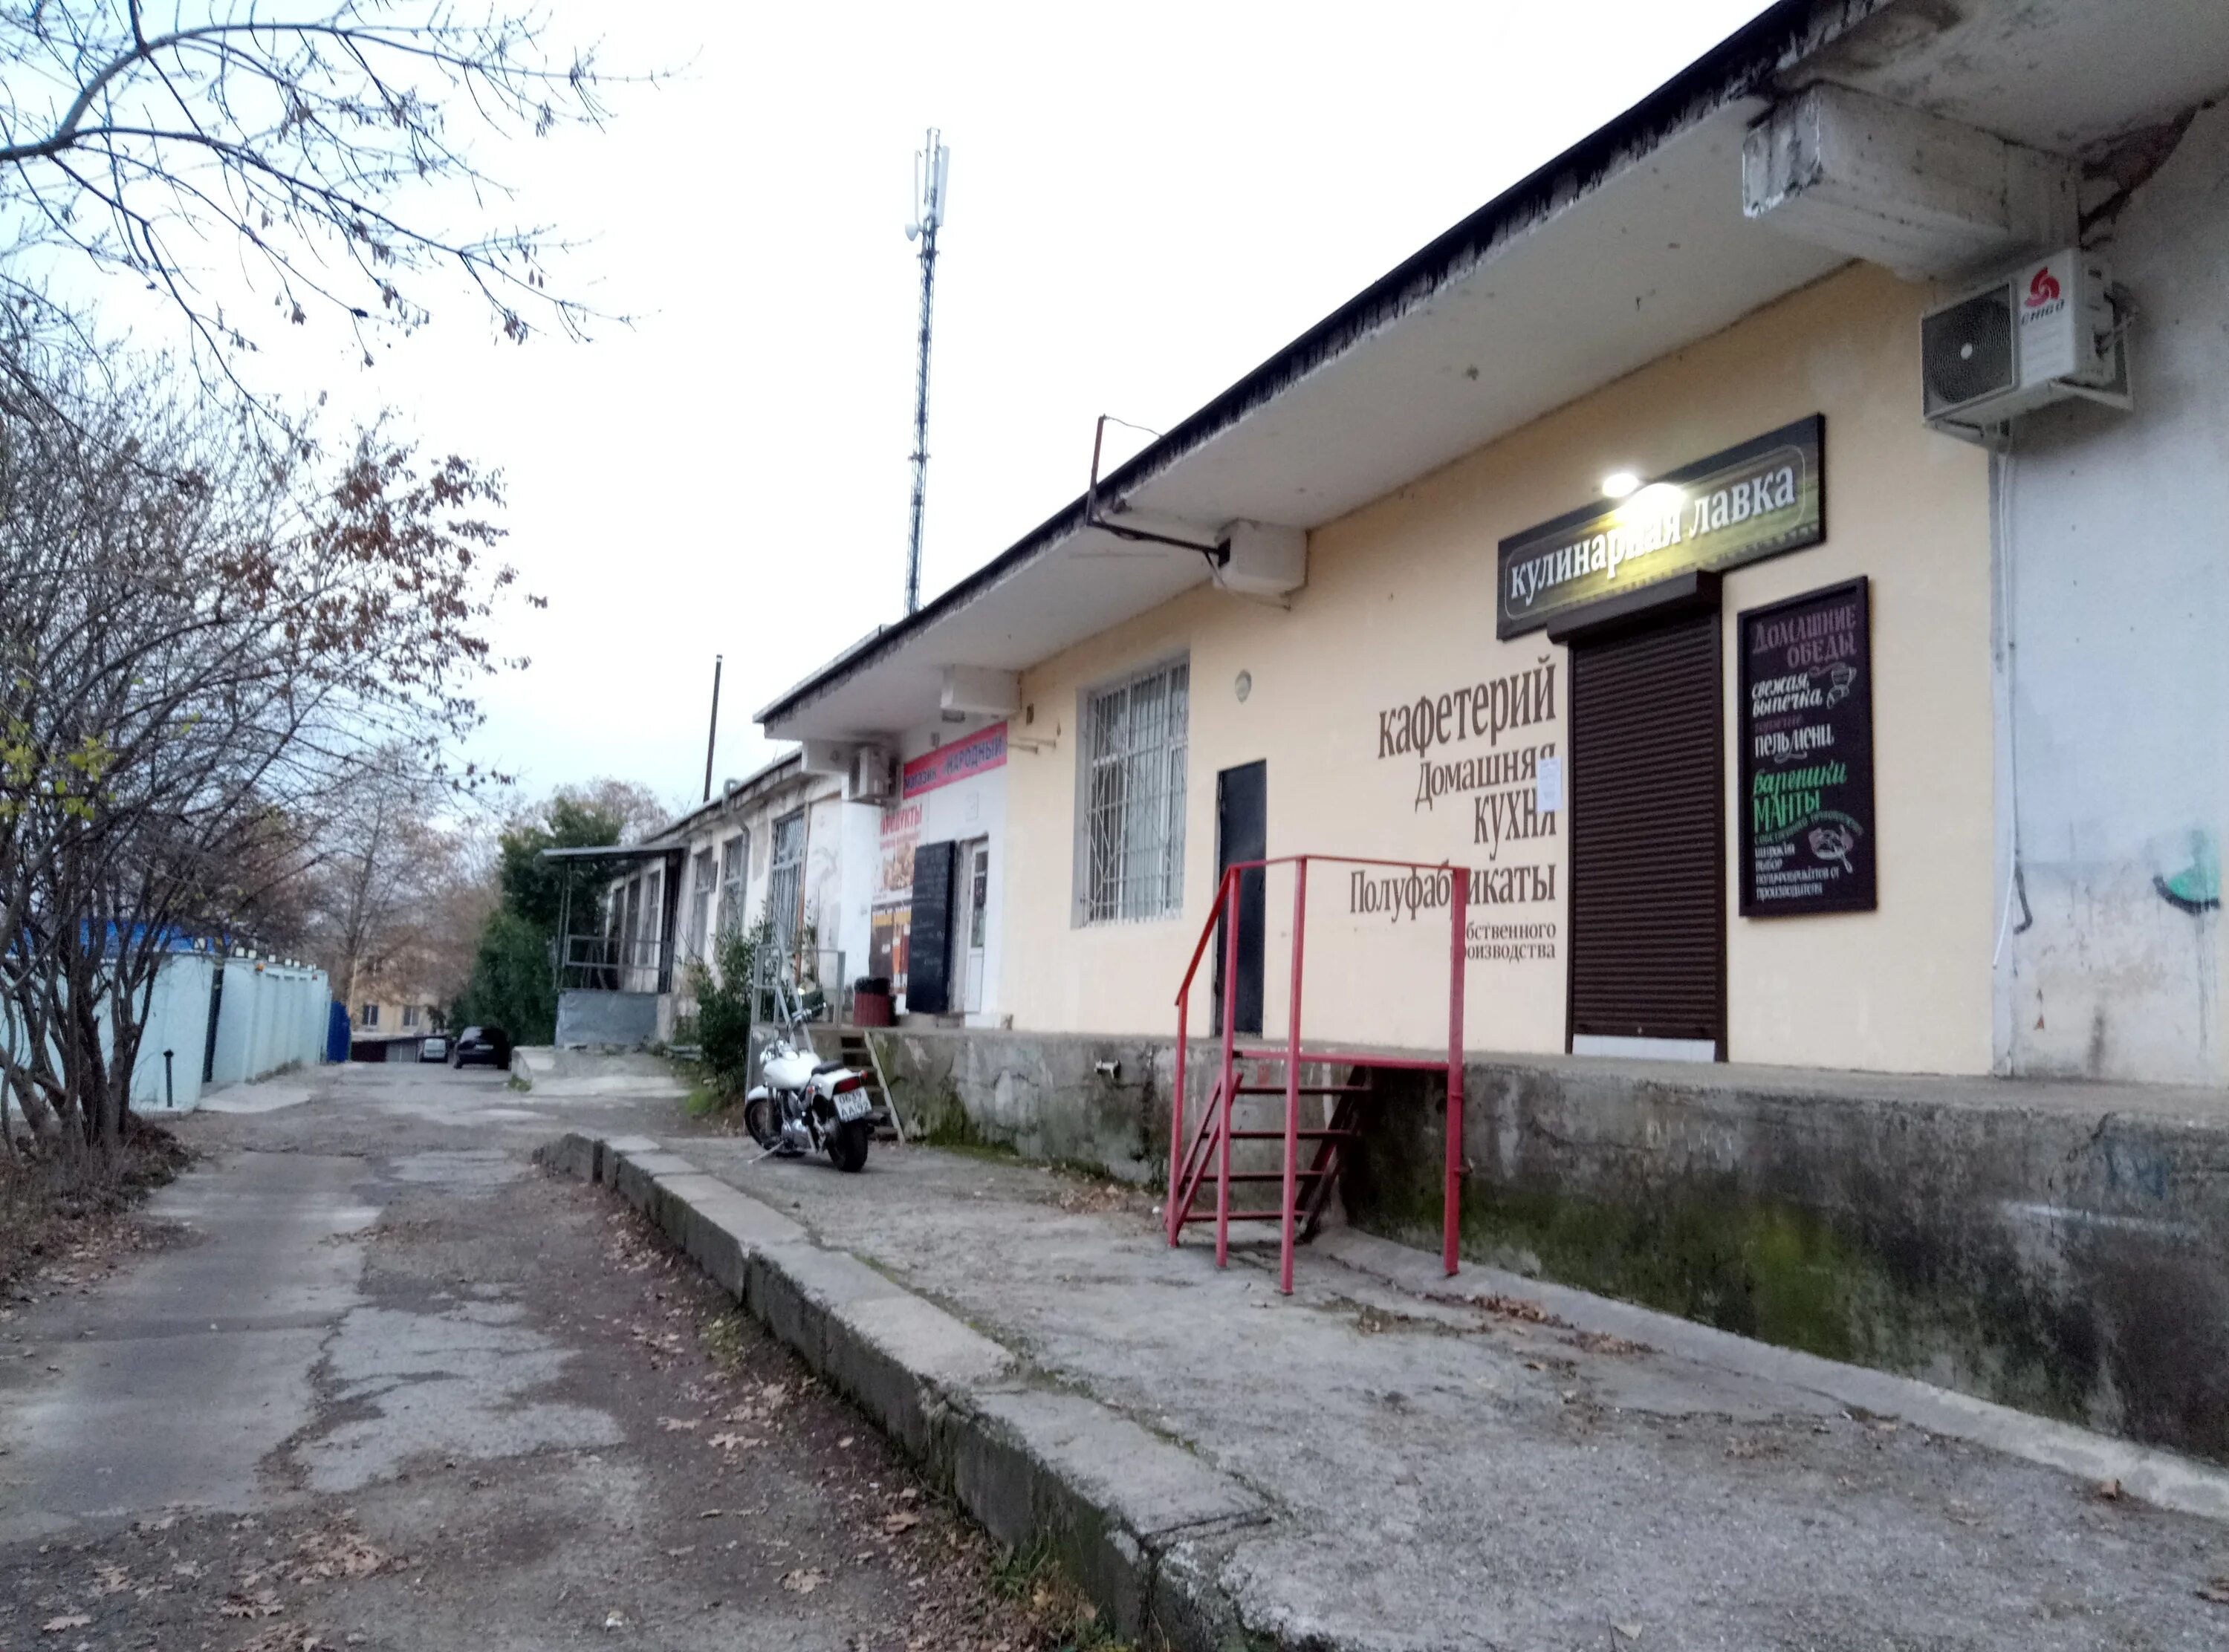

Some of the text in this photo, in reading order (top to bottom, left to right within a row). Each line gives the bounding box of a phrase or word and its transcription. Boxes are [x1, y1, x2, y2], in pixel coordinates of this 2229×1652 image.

[1688, 466, 1796, 539] лавка
[1378, 654, 1557, 759] кафетерий
[1349, 860, 1557, 923] Полуфабикаты
[1466, 922, 1557, 943] бственного
[1466, 943, 1556, 964] оизводства
